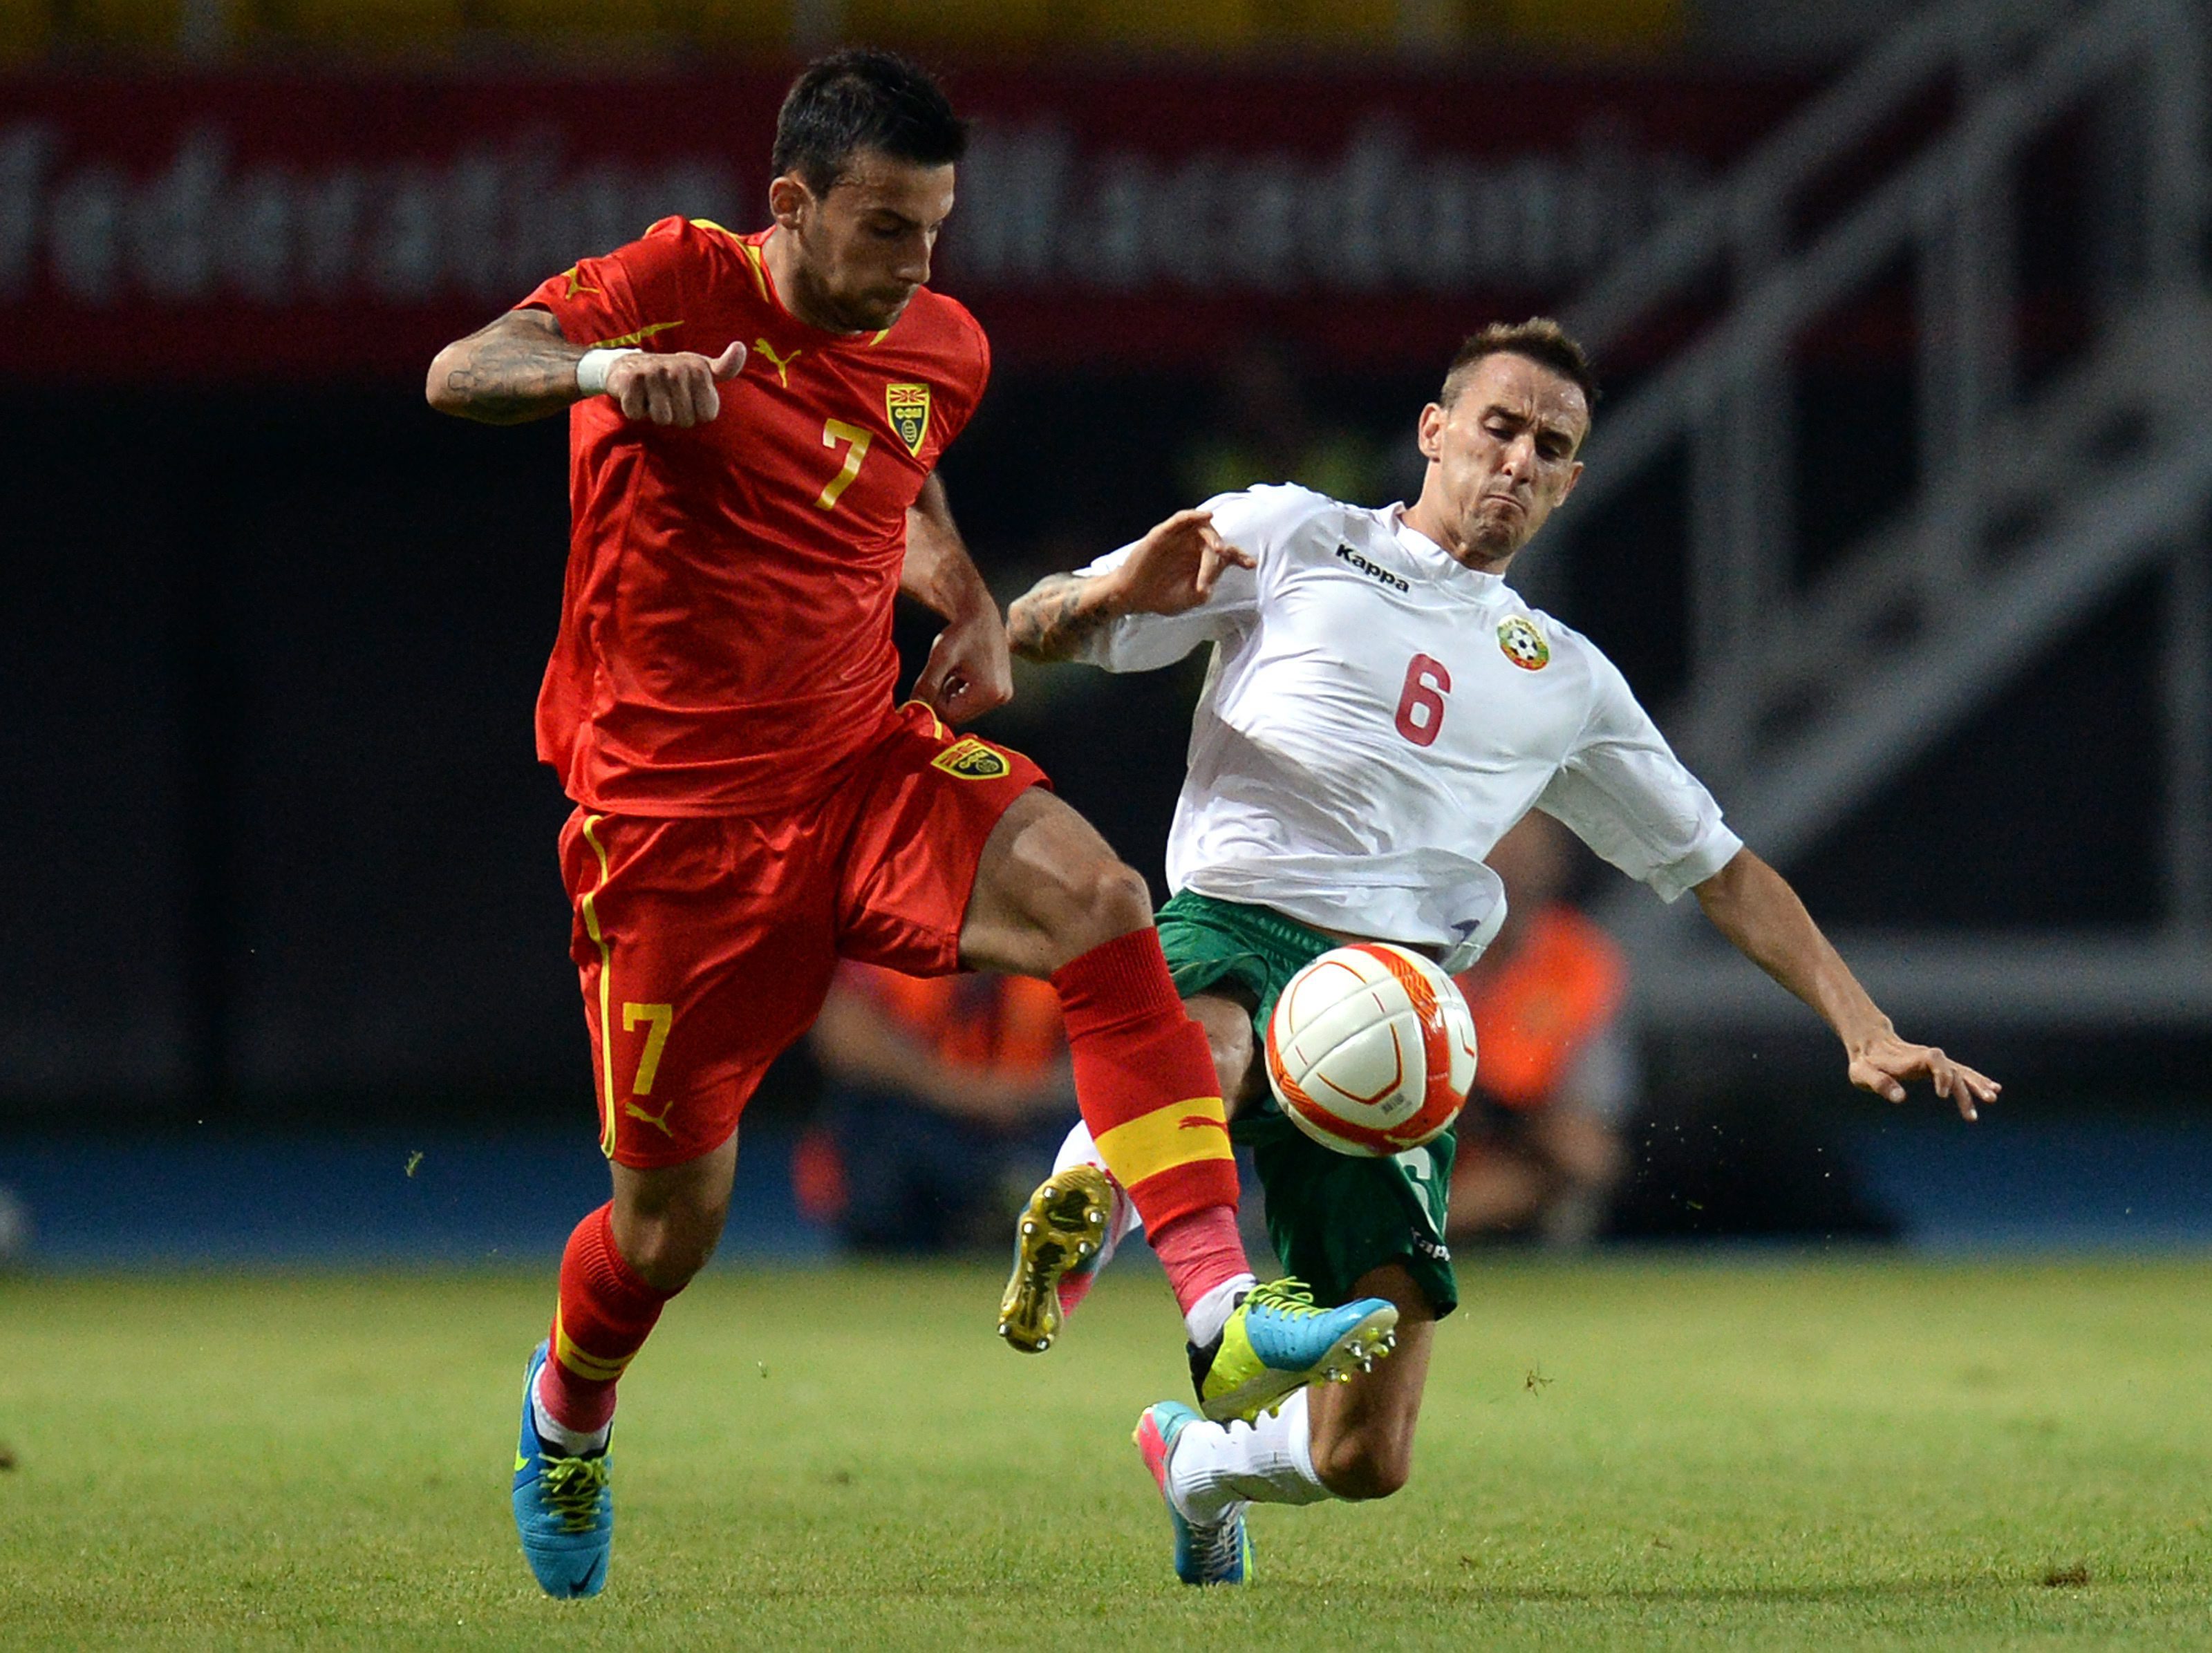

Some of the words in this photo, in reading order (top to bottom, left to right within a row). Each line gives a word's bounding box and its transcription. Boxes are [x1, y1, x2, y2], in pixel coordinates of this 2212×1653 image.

[814, 417, 874, 510] 7
[1335, 543, 1409, 593] Kappa
[1395, 653, 1451, 747] 6
[623, 1002, 673, 1095] 7
